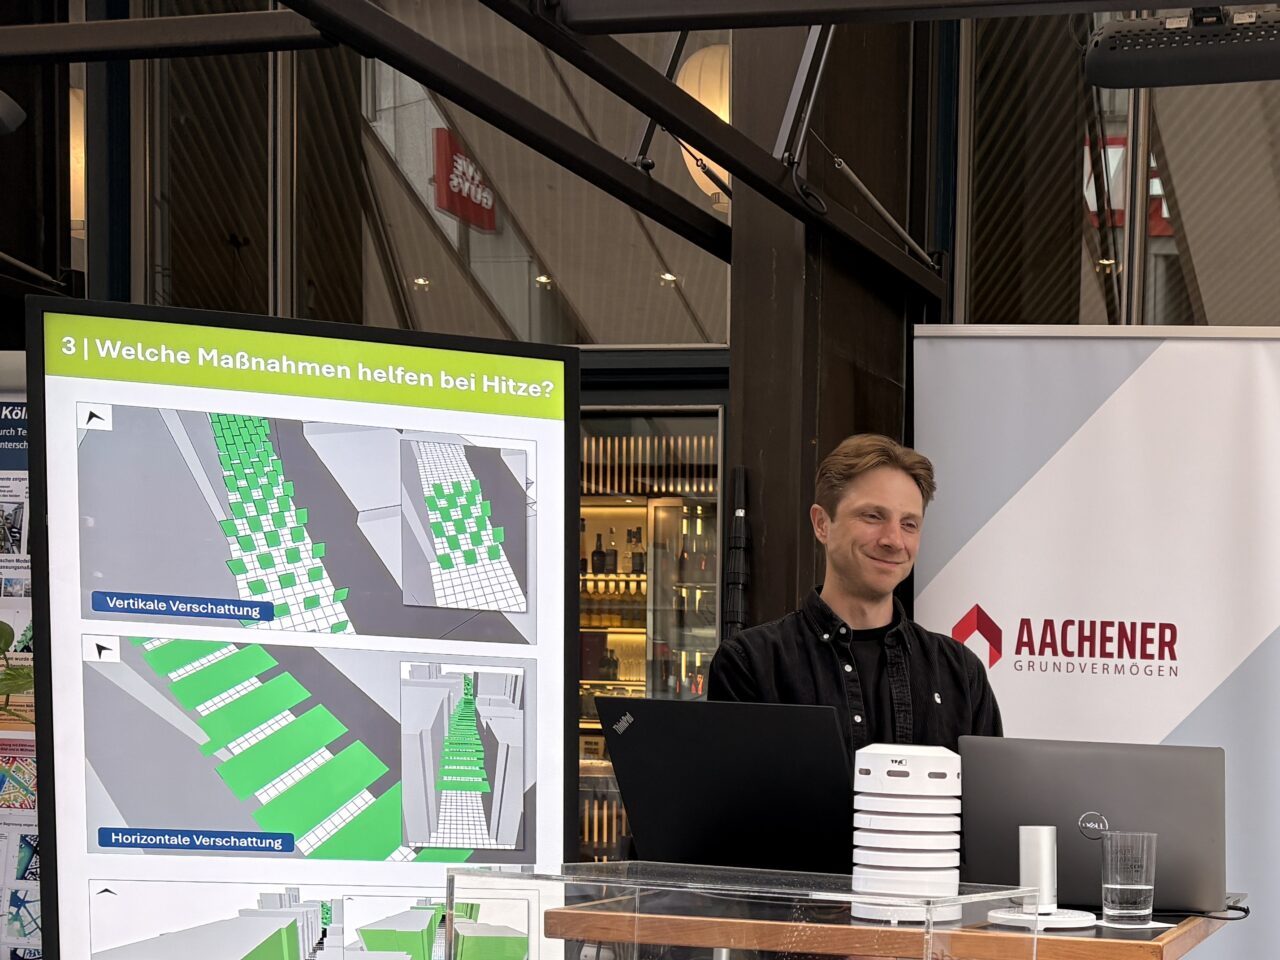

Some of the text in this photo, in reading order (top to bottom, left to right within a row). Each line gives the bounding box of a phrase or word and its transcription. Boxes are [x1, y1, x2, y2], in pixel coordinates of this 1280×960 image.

[61, 336, 76, 355] 3
[95, 338, 191, 365] Welche
[198, 347, 351, 379] Maßnahmen
[358, 362, 433, 387] helfen
[440, 370, 476, 391] bei
[482, 375, 554, 398] Hitze?
[1, 406, 28, 420] Köl
[106, 596, 261, 618] Vertikale Verschattung
[1014, 618, 1179, 661] AACHENER
[1013, 660, 1179, 677] GRUNDVERMÖGEN
[111, 832, 282, 850] Horizontale Verschattung
